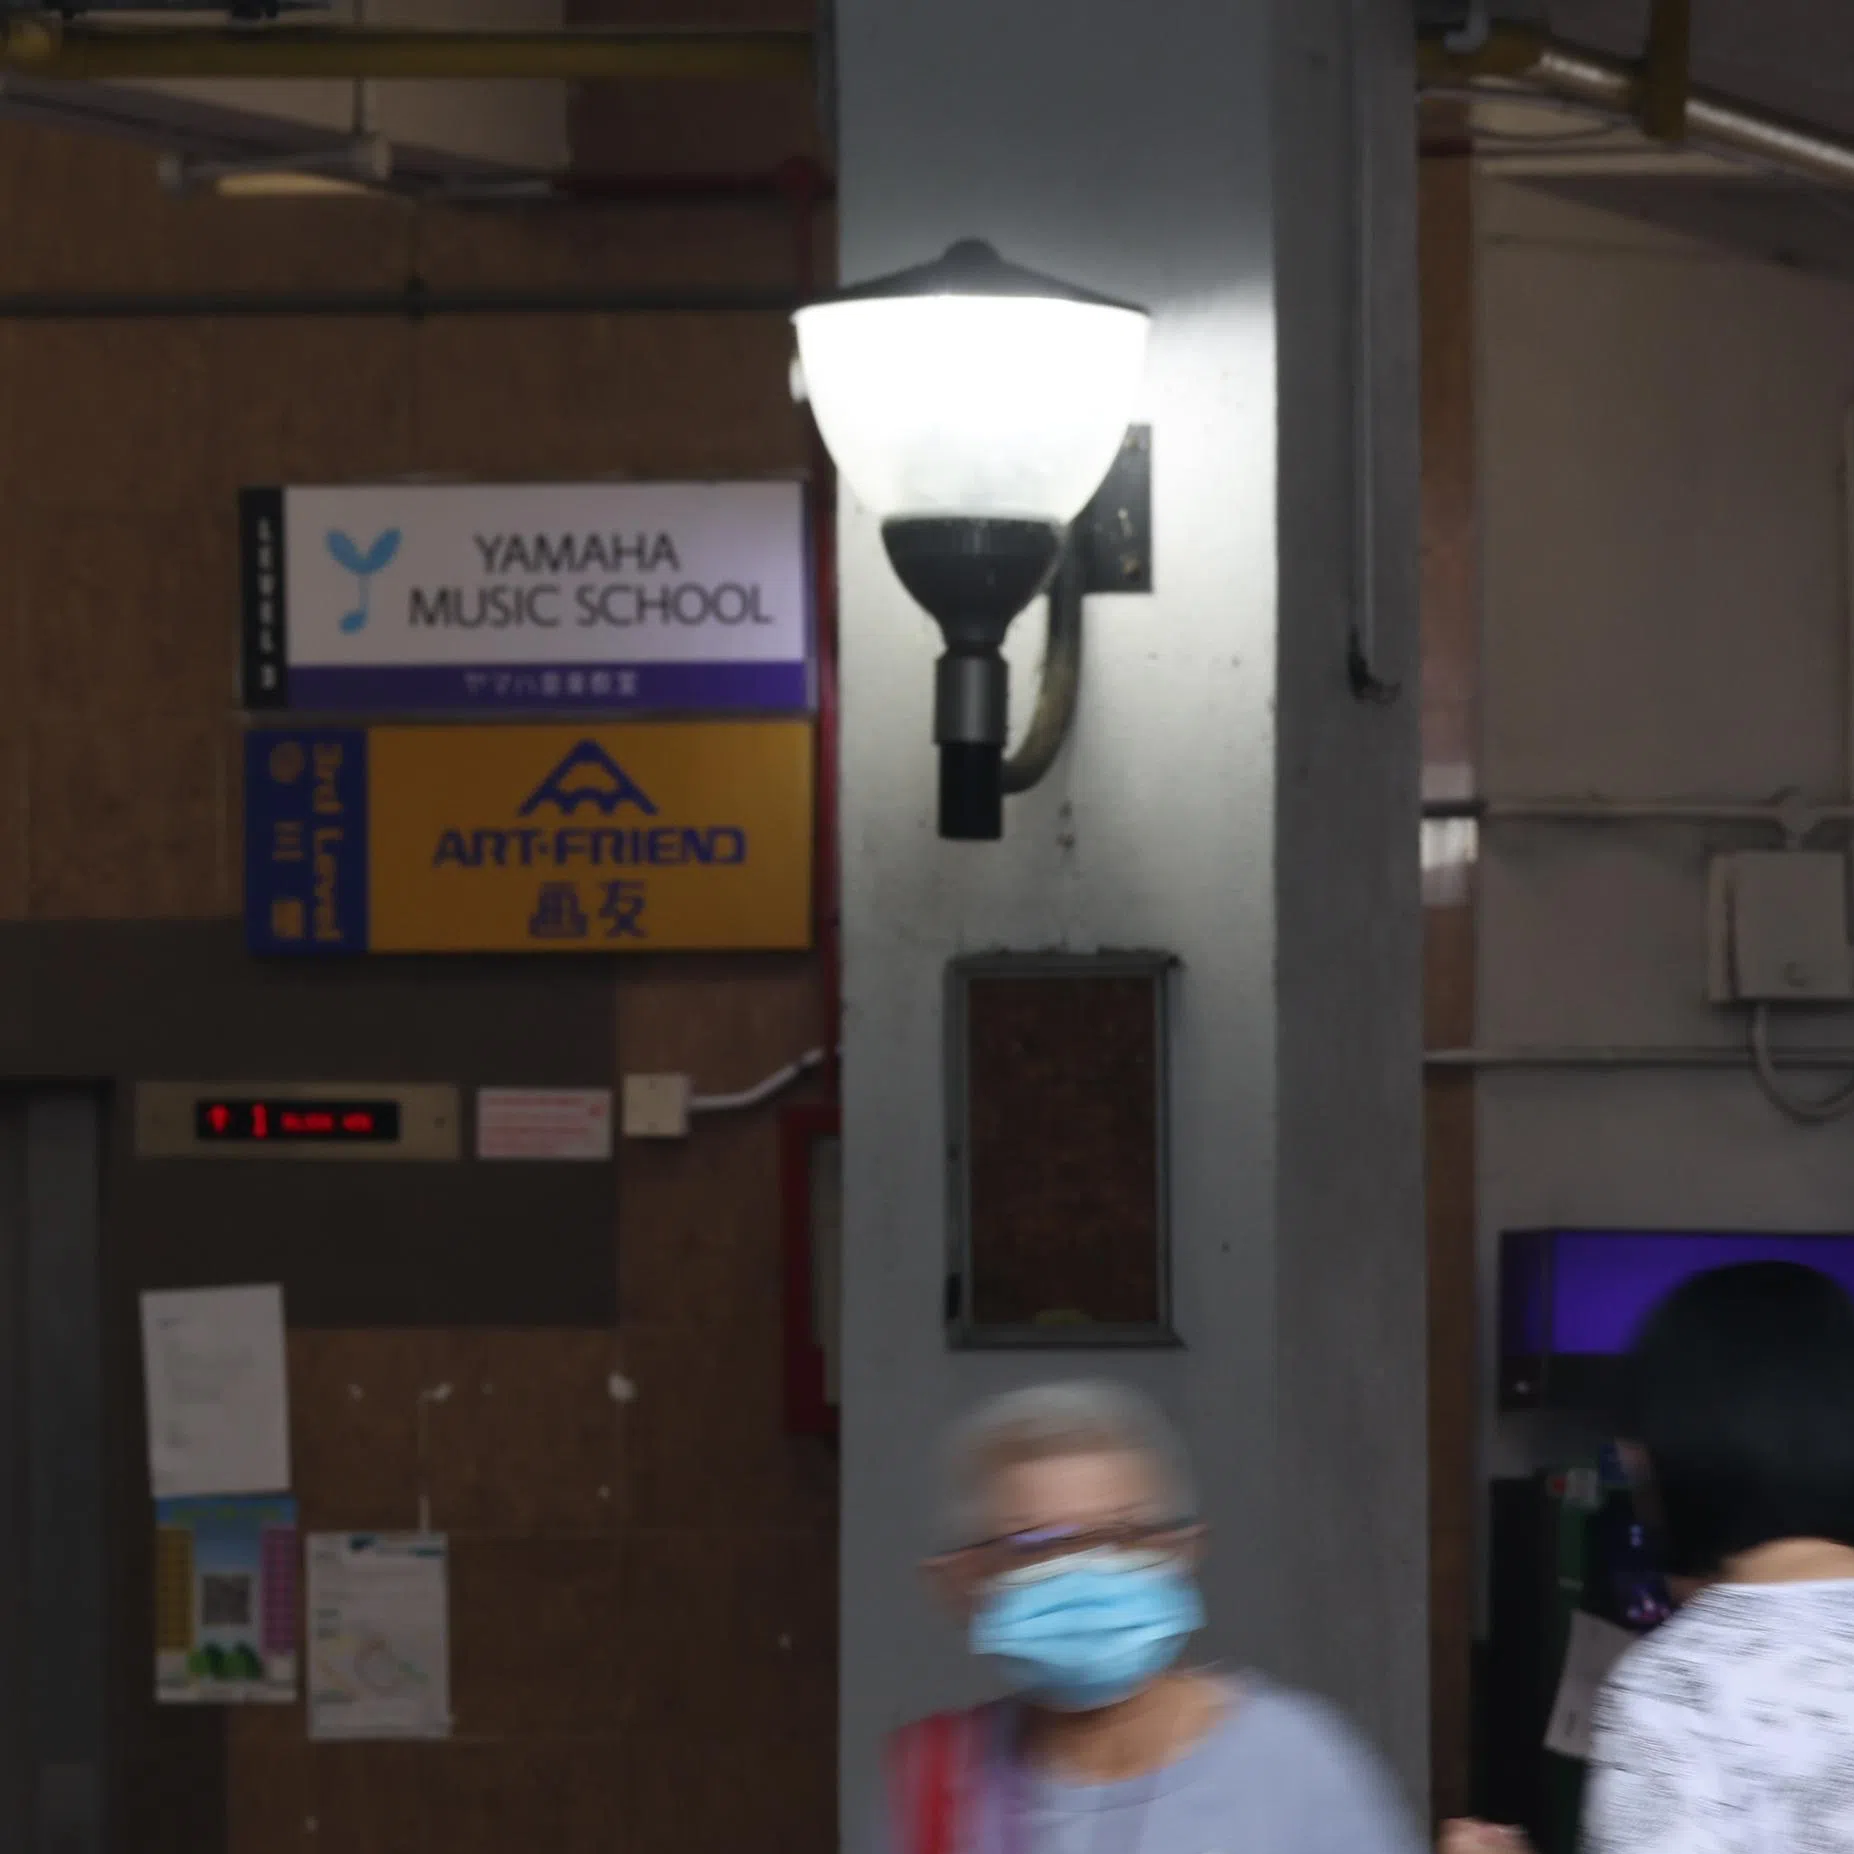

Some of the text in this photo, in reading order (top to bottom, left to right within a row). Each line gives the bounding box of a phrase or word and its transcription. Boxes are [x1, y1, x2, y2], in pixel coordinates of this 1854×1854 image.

[473, 532, 681, 573] YAMAHA
[409, 584, 773, 628] MUSIC SCHOOL
